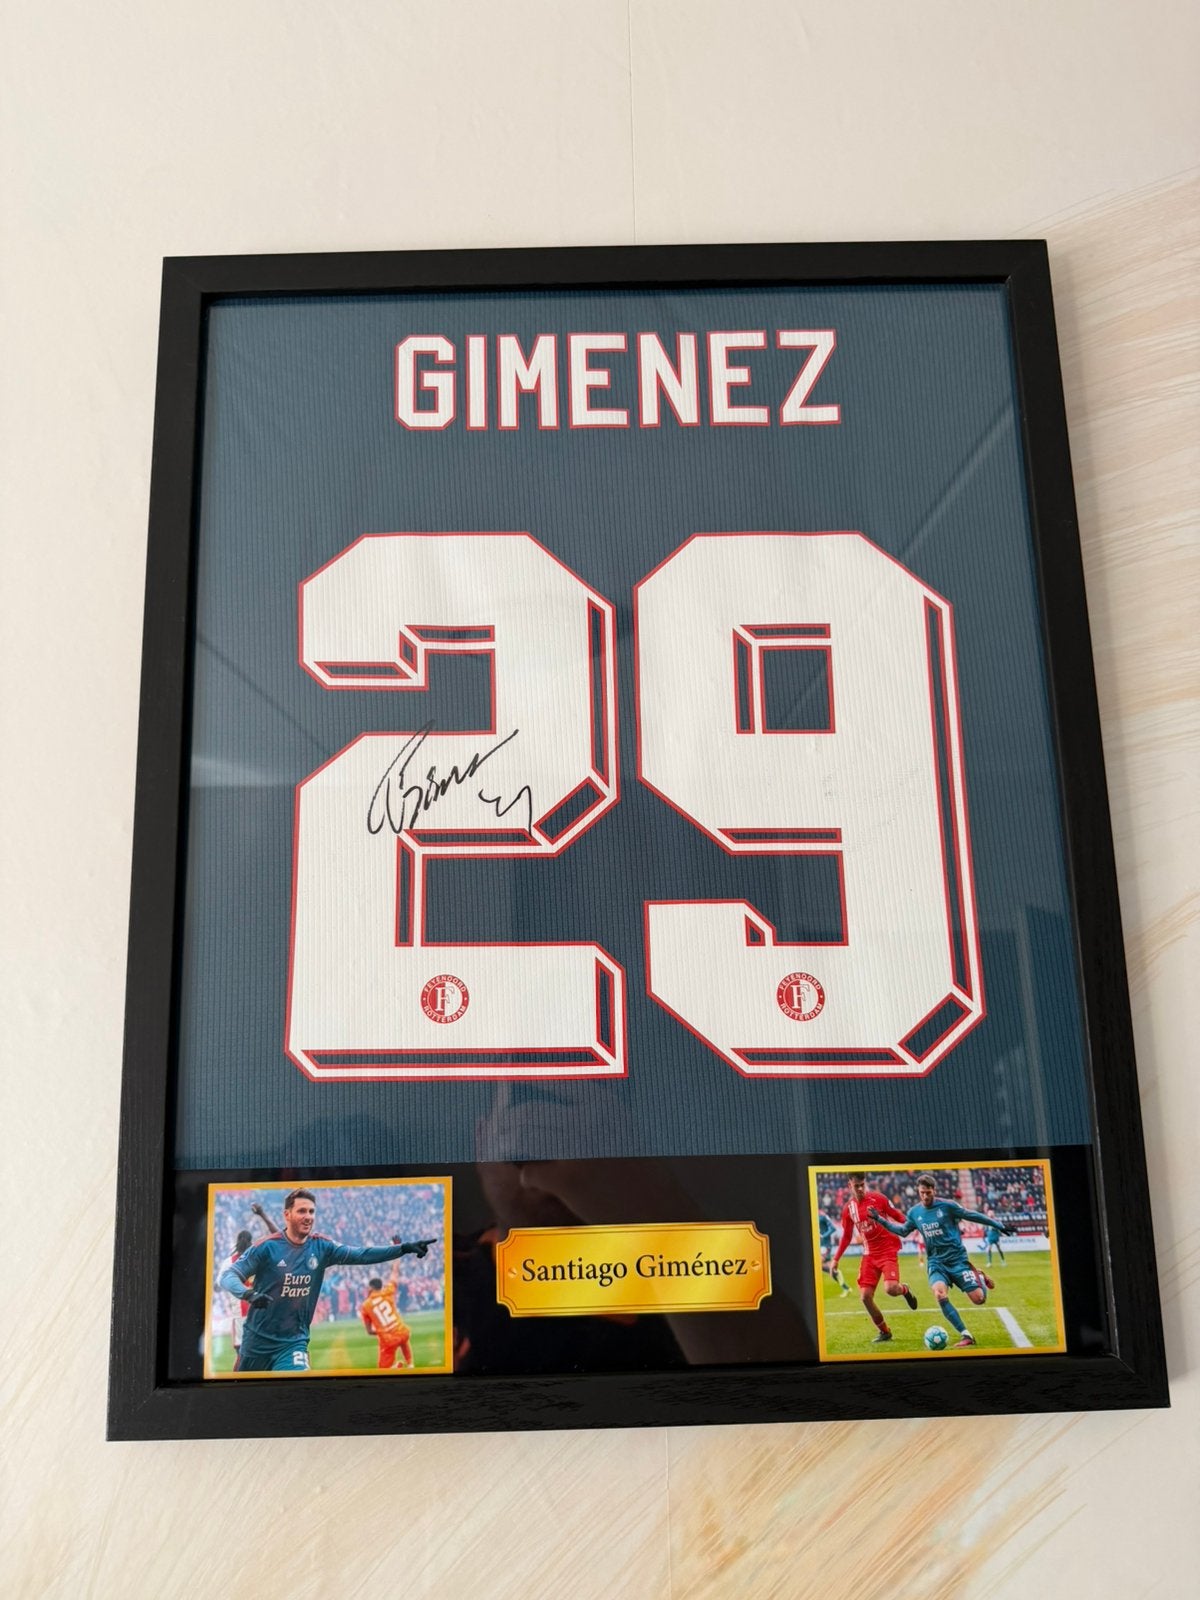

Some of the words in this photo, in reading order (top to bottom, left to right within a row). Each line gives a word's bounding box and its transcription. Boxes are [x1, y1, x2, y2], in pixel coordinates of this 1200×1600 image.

[395, 329, 841, 430] GIMENEZ
[285, 531, 987, 1081] 29
[283, 1272, 312, 1286] Euro
[522, 1257, 628, 1287] Santiago
[635, 1252, 748, 1279] Giménez
[280, 1285, 311, 1298] Parcs
[372, 1299, 398, 1327] 12
